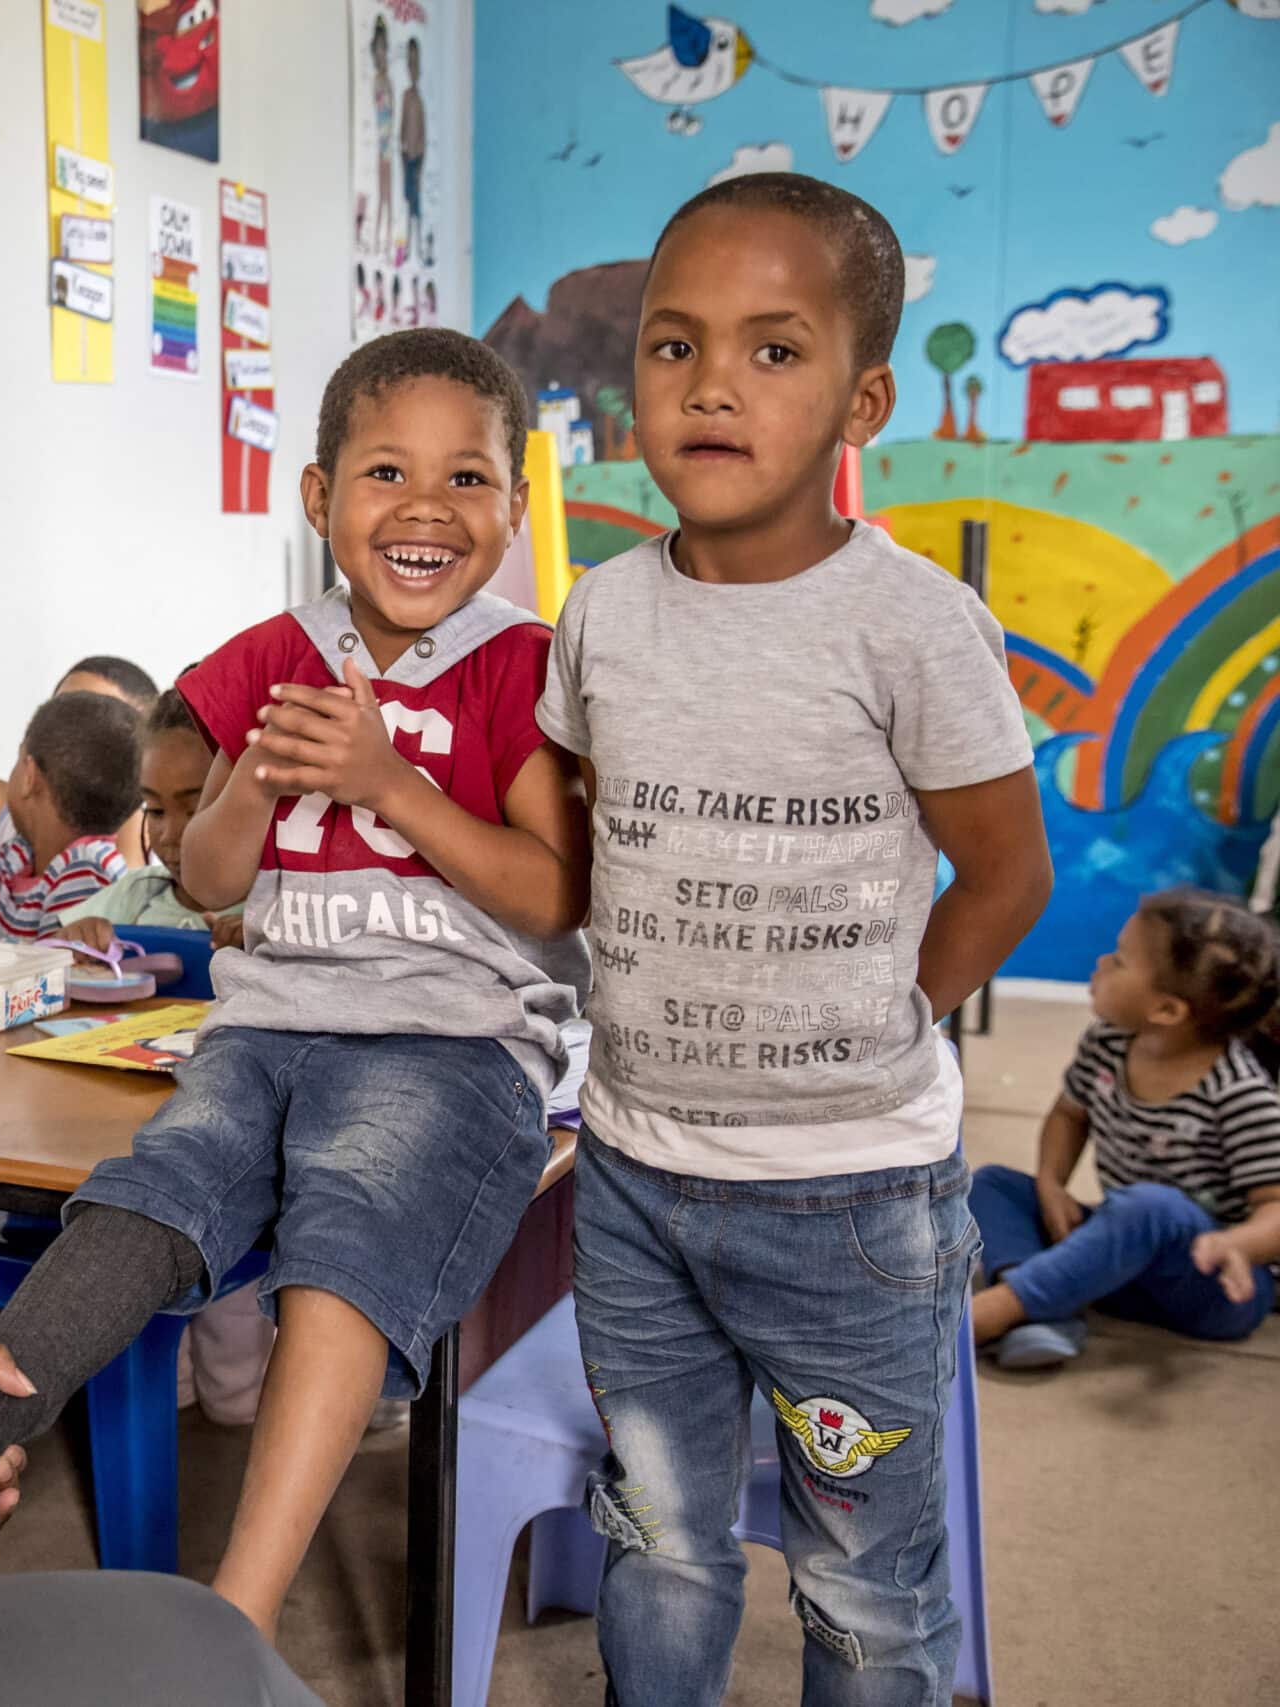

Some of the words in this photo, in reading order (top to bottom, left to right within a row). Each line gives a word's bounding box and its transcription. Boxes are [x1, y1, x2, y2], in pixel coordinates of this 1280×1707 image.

[835, 37, 1165, 133] HOPE
[633, 781, 685, 814] BIG.
[697, 789, 777, 823] TAKE
[785, 794, 881, 826] RISKS
[765, 833, 796, 864] IT
[675, 878, 759, 912] SET@
[768, 883, 849, 913] PALS
[617, 907, 665, 943] BIG.
[676, 917, 756, 952] TAKE
[766, 922, 863, 952] RISKS
[663, 998, 745, 1032] SET@
[756, 1003, 841, 1032] PALS
[610, 1022, 660, 1058] BIG.
[666, 1037, 747, 1069] TAKE
[758, 1037, 852, 1069] RISKS
